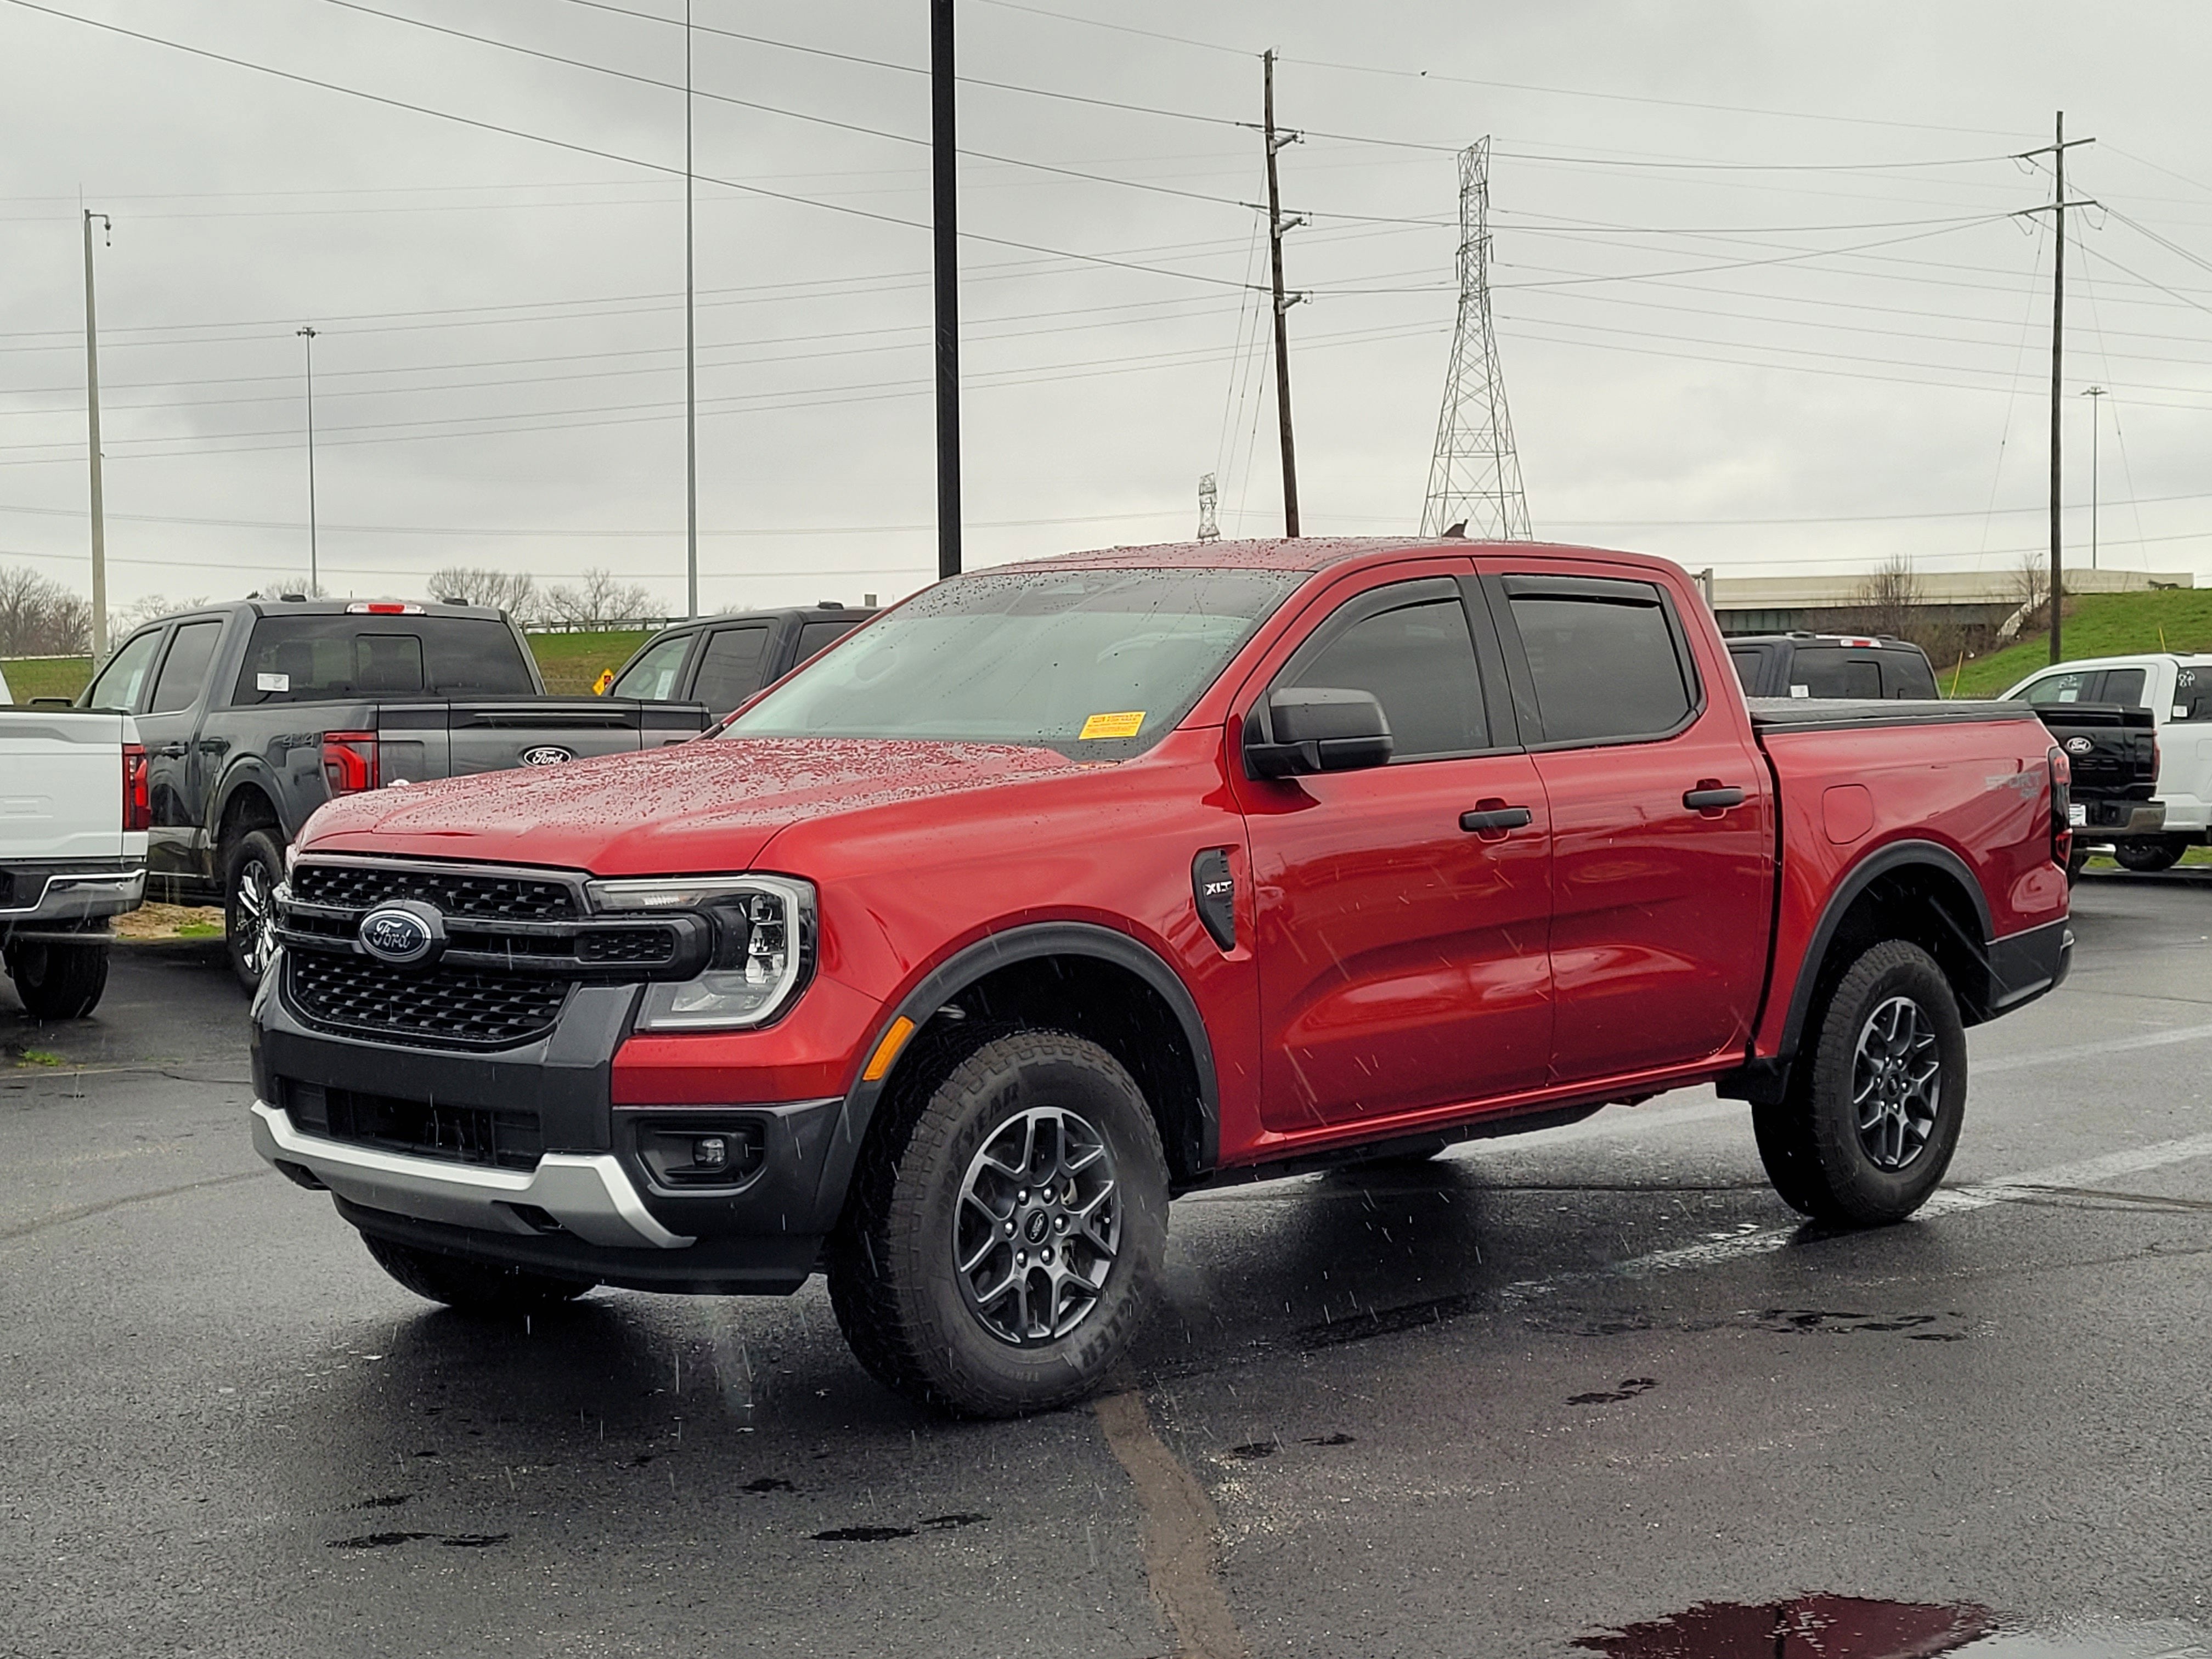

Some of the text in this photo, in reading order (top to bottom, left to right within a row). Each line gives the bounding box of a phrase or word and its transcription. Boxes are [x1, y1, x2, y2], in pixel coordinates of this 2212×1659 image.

[532, 750, 563, 764] Ford
[1205, 880, 1233, 896] XLT
[372, 919, 411, 949] Ford
